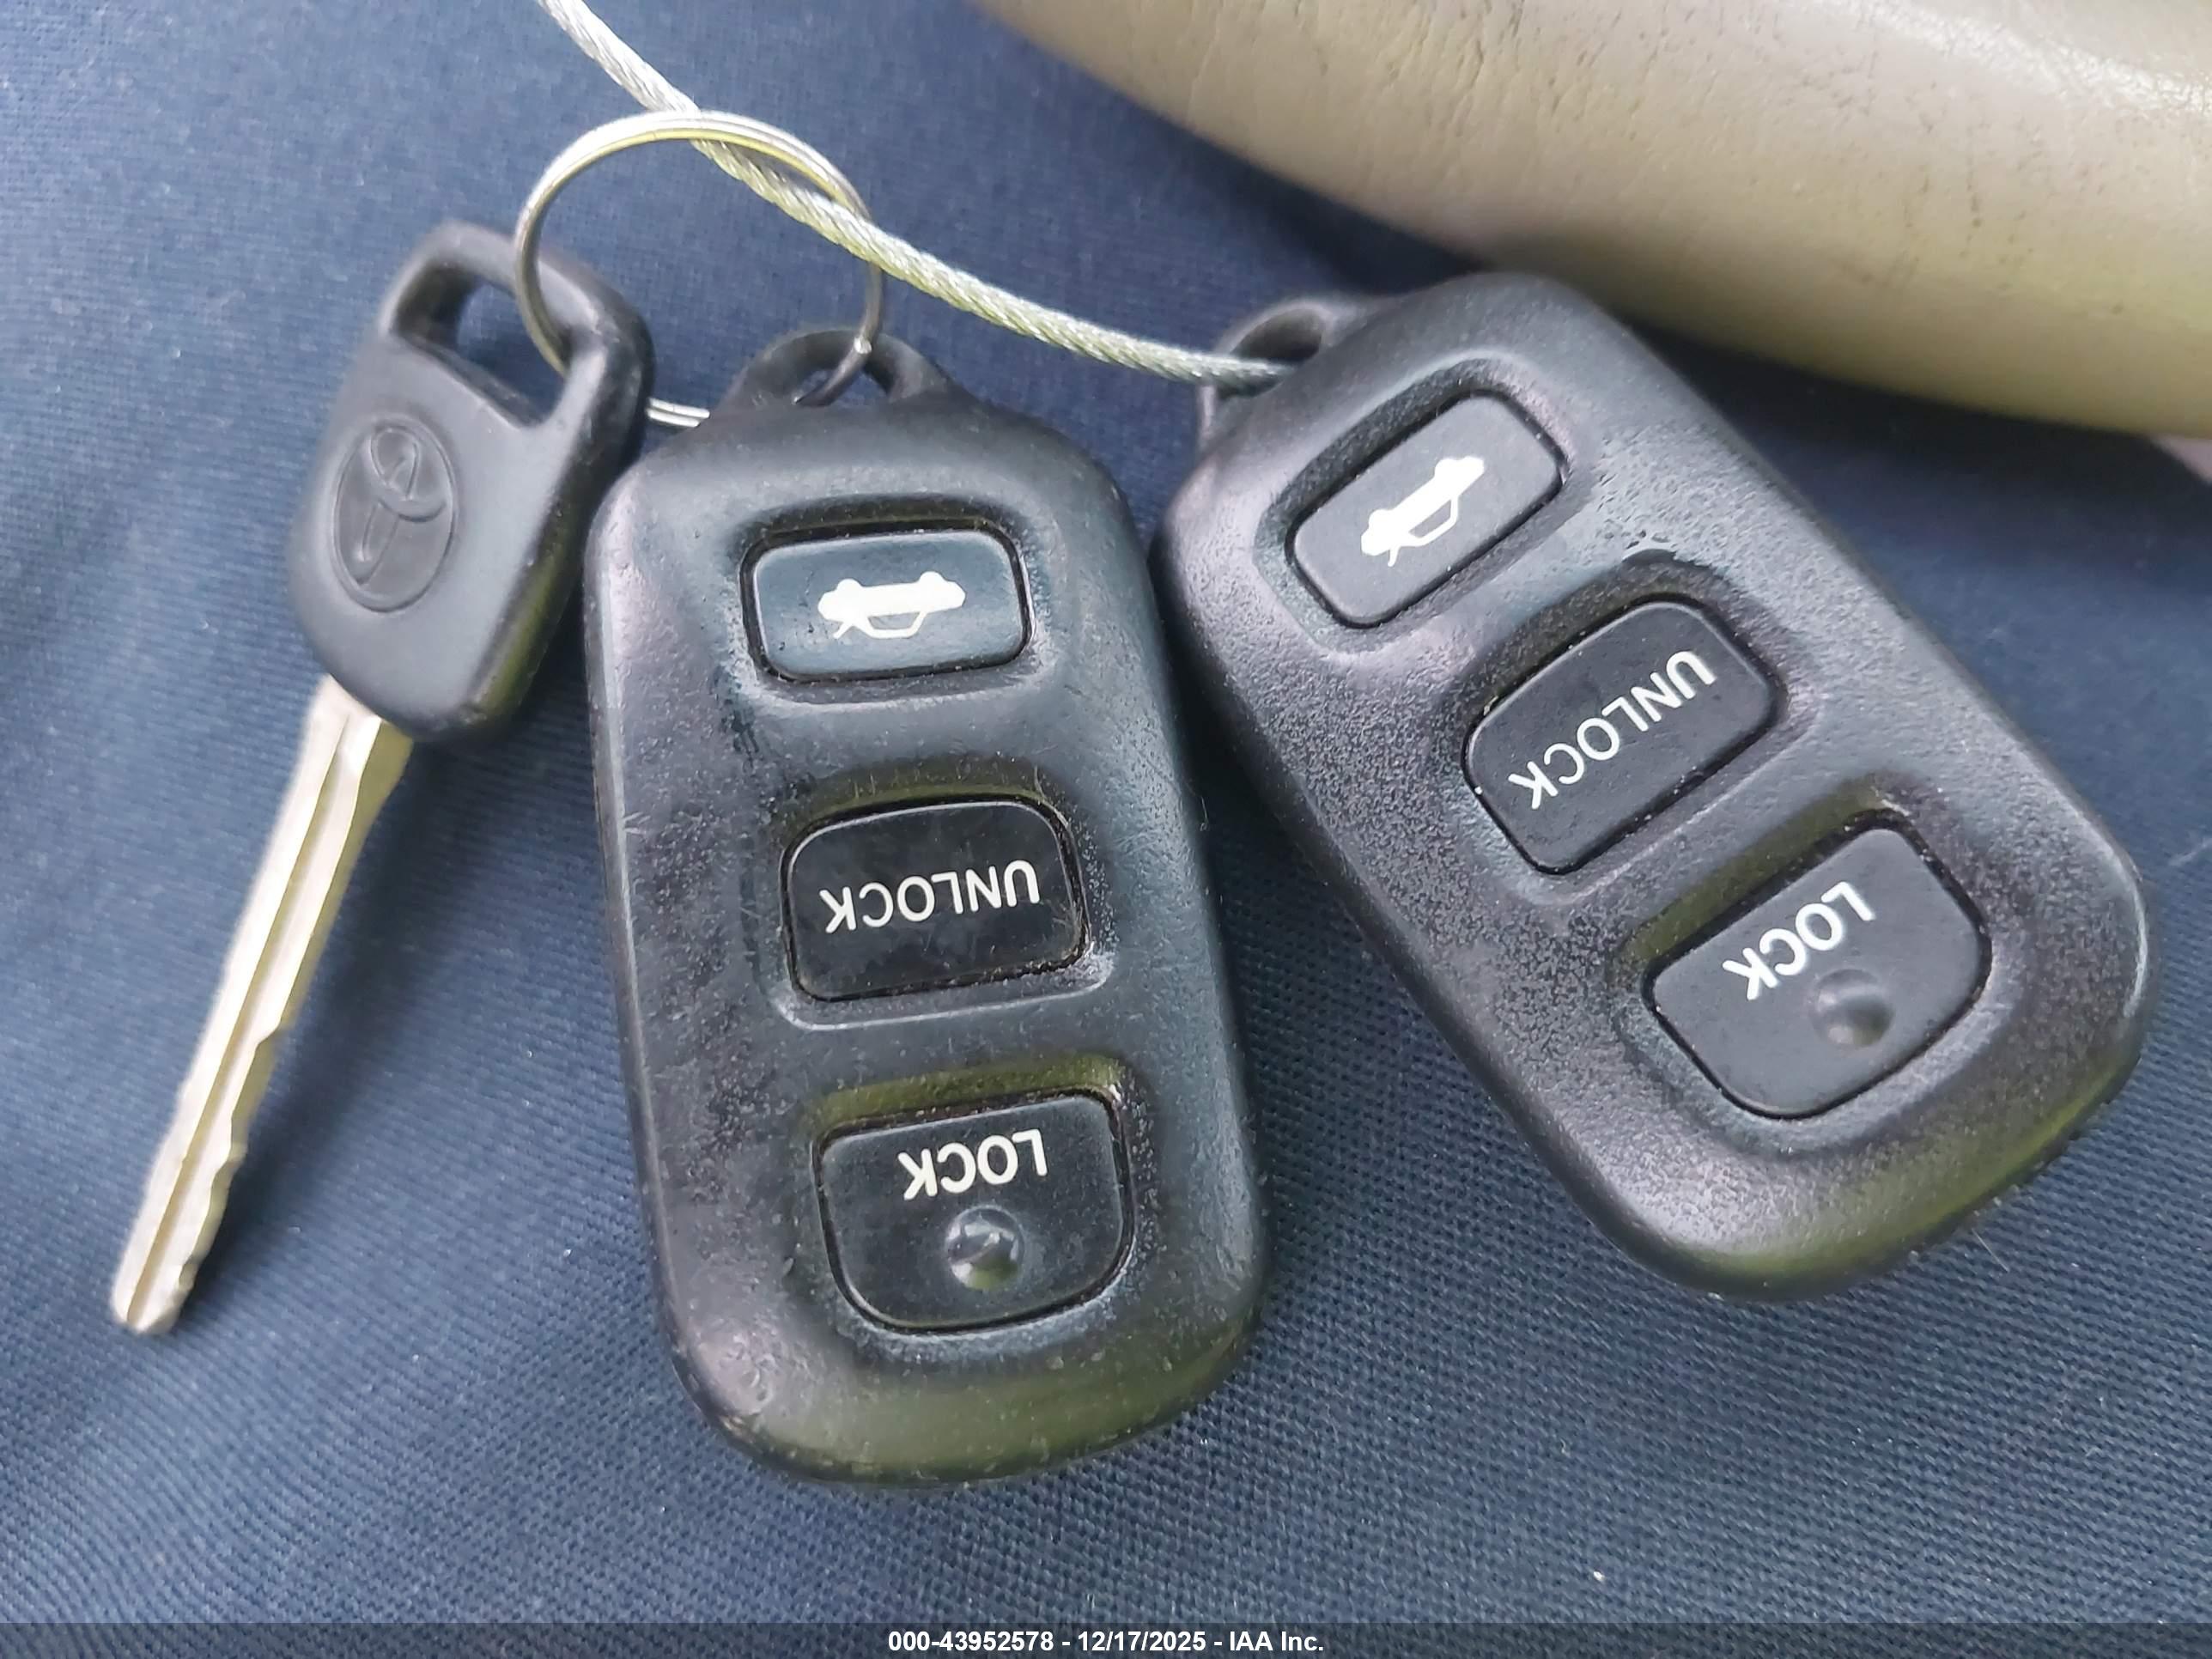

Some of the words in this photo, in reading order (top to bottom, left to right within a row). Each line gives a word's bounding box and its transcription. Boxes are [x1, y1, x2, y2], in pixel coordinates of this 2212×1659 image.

[1507, 650, 1718, 810] UNLOCK
[818, 860, 1041, 933] UNLOCK
[1722, 881, 1877, 1002] LOCK
[897, 1128, 1048, 1201] LOCK
